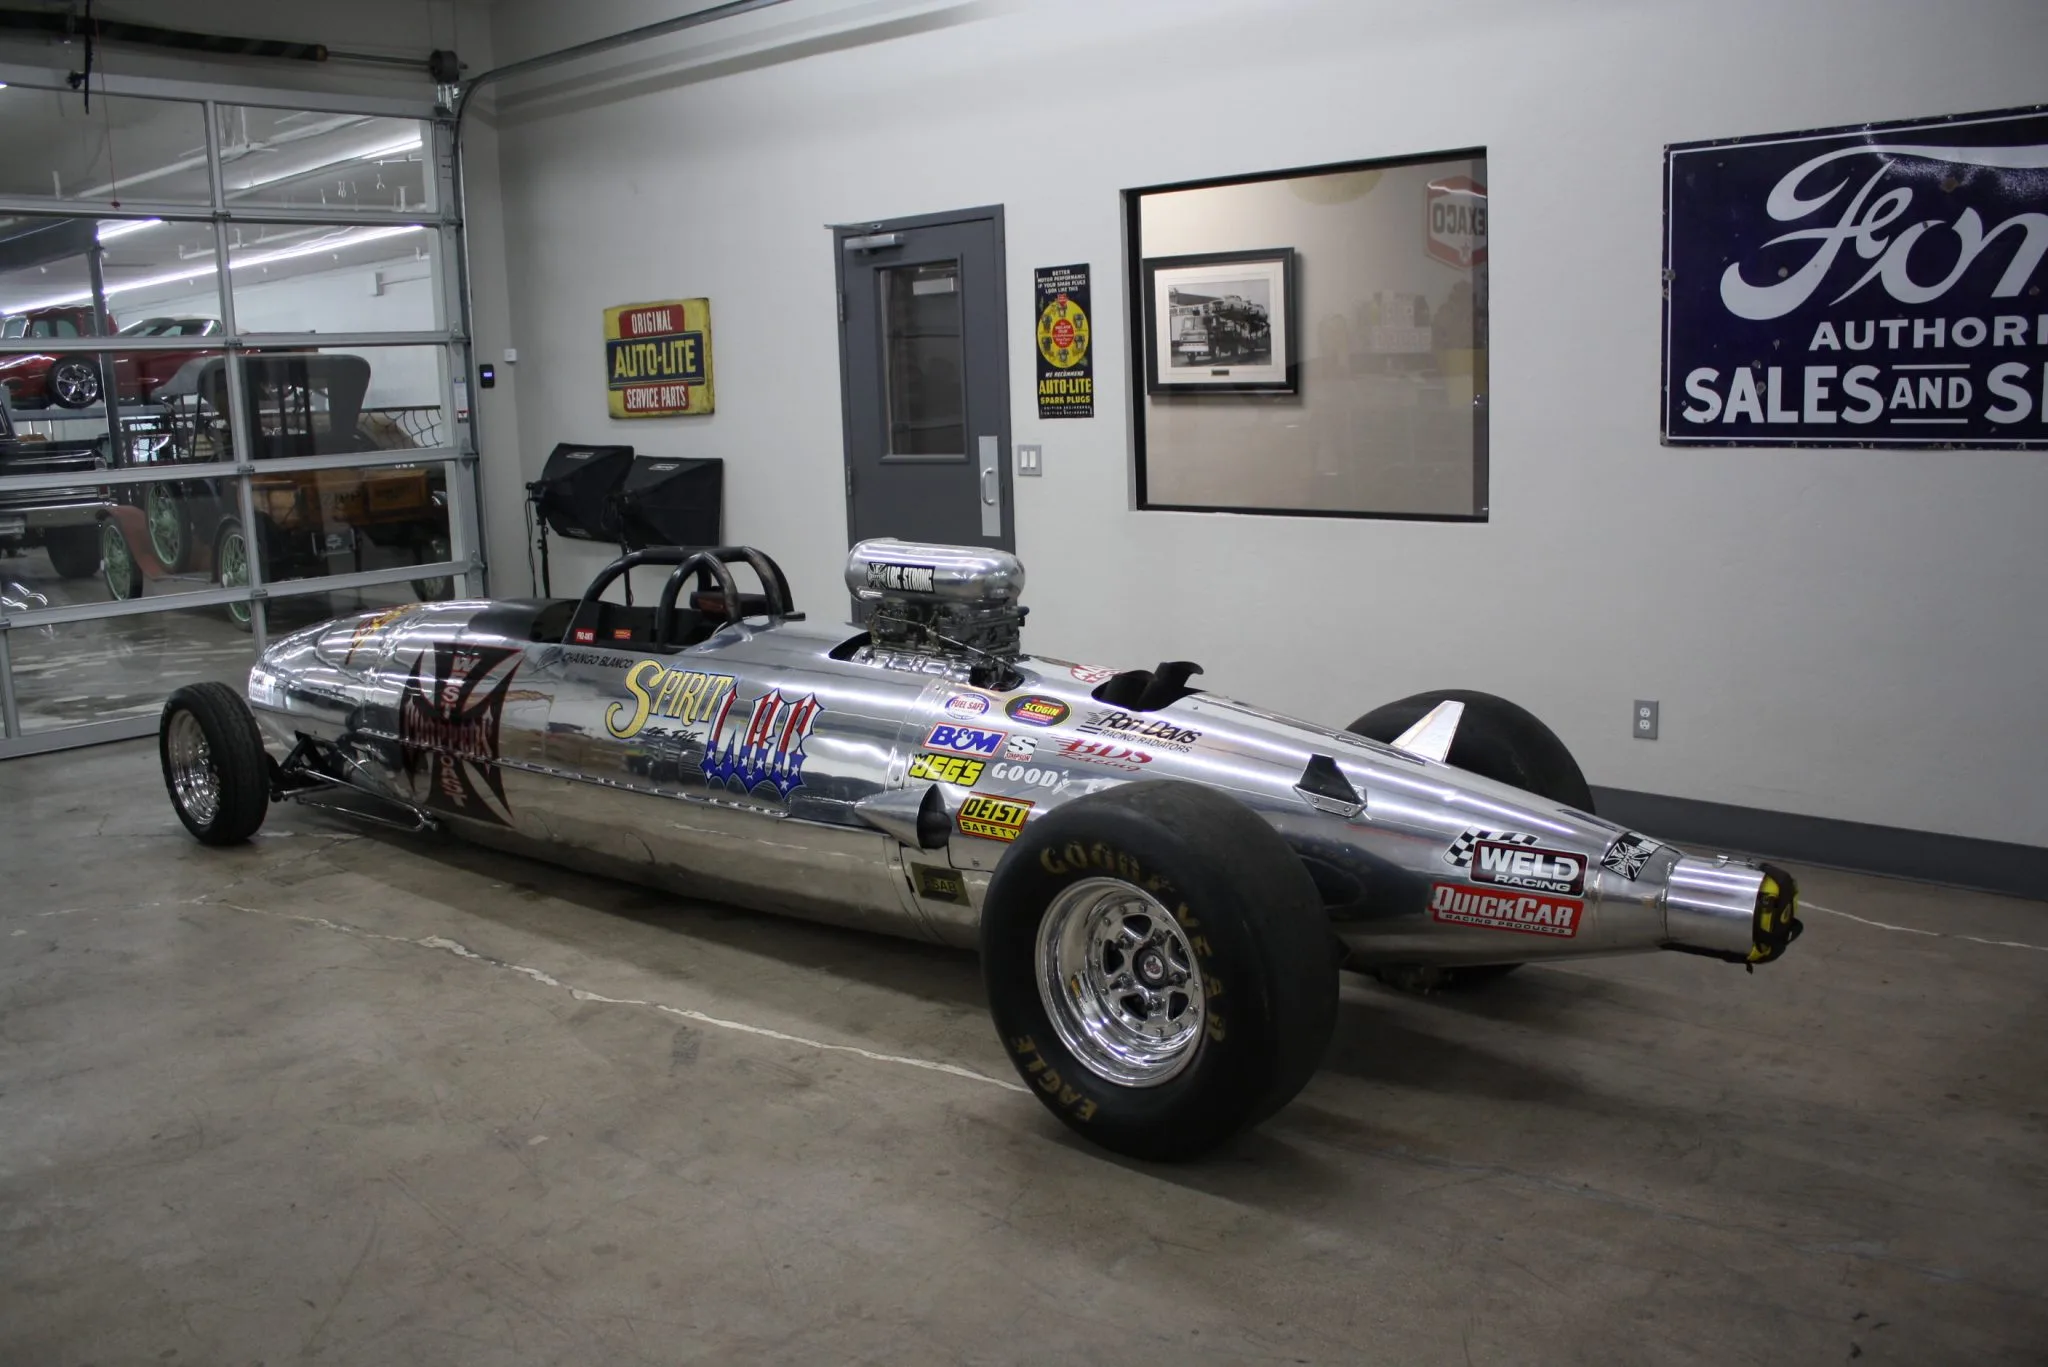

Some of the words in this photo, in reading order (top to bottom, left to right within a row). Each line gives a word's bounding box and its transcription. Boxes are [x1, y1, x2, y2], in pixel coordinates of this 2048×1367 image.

[631, 309, 673, 334] ORIGINAL
[614, 339, 697, 378] AUTO-LITE
[626, 387, 659, 409] SERVICE
[661, 385, 686, 407] PARTS
[1039, 378, 1092, 395] AUTO-LITE
[1682, 364, 1885, 425] SALES
[1889, 376, 1973, 410] AND
[1984, 362, 2048, 425] S
[1040, 396, 1065, 405] SPARK
[1066, 395, 1091, 404] PLUGS
[902, 567, 933, 592] STRONG
[561, 651, 599, 665] CHANGO
[598, 655, 634, 669] BLANCO
[951, 699, 967, 709] FUEL
[967, 701, 985, 711] SAFE
[671, 729, 705, 743] THE
[928, 725, 1004, 753] B&M
[1097, 710, 1145, 731] Ron
[1142, 720, 1203, 743] Davis
[1062, 738, 1153, 764] BDS
[1099, 729, 1135, 742] RACING
[1136, 734, 1193, 754] RADIATORS
[1006, 752, 1031, 762] SIMPSON
[909, 754, 984, 786] JEG'S
[963, 798, 1025, 823] DEIST
[962, 822, 1018, 838] SAFETY
[1480, 846, 1580, 881] WELD
[1494, 874, 1572, 892] RACING
[1445, 914, 1492, 925] RACING
[1498, 921, 1567, 934] PRODUCTS
[1010, 1033, 1099, 1122] EAGLE
